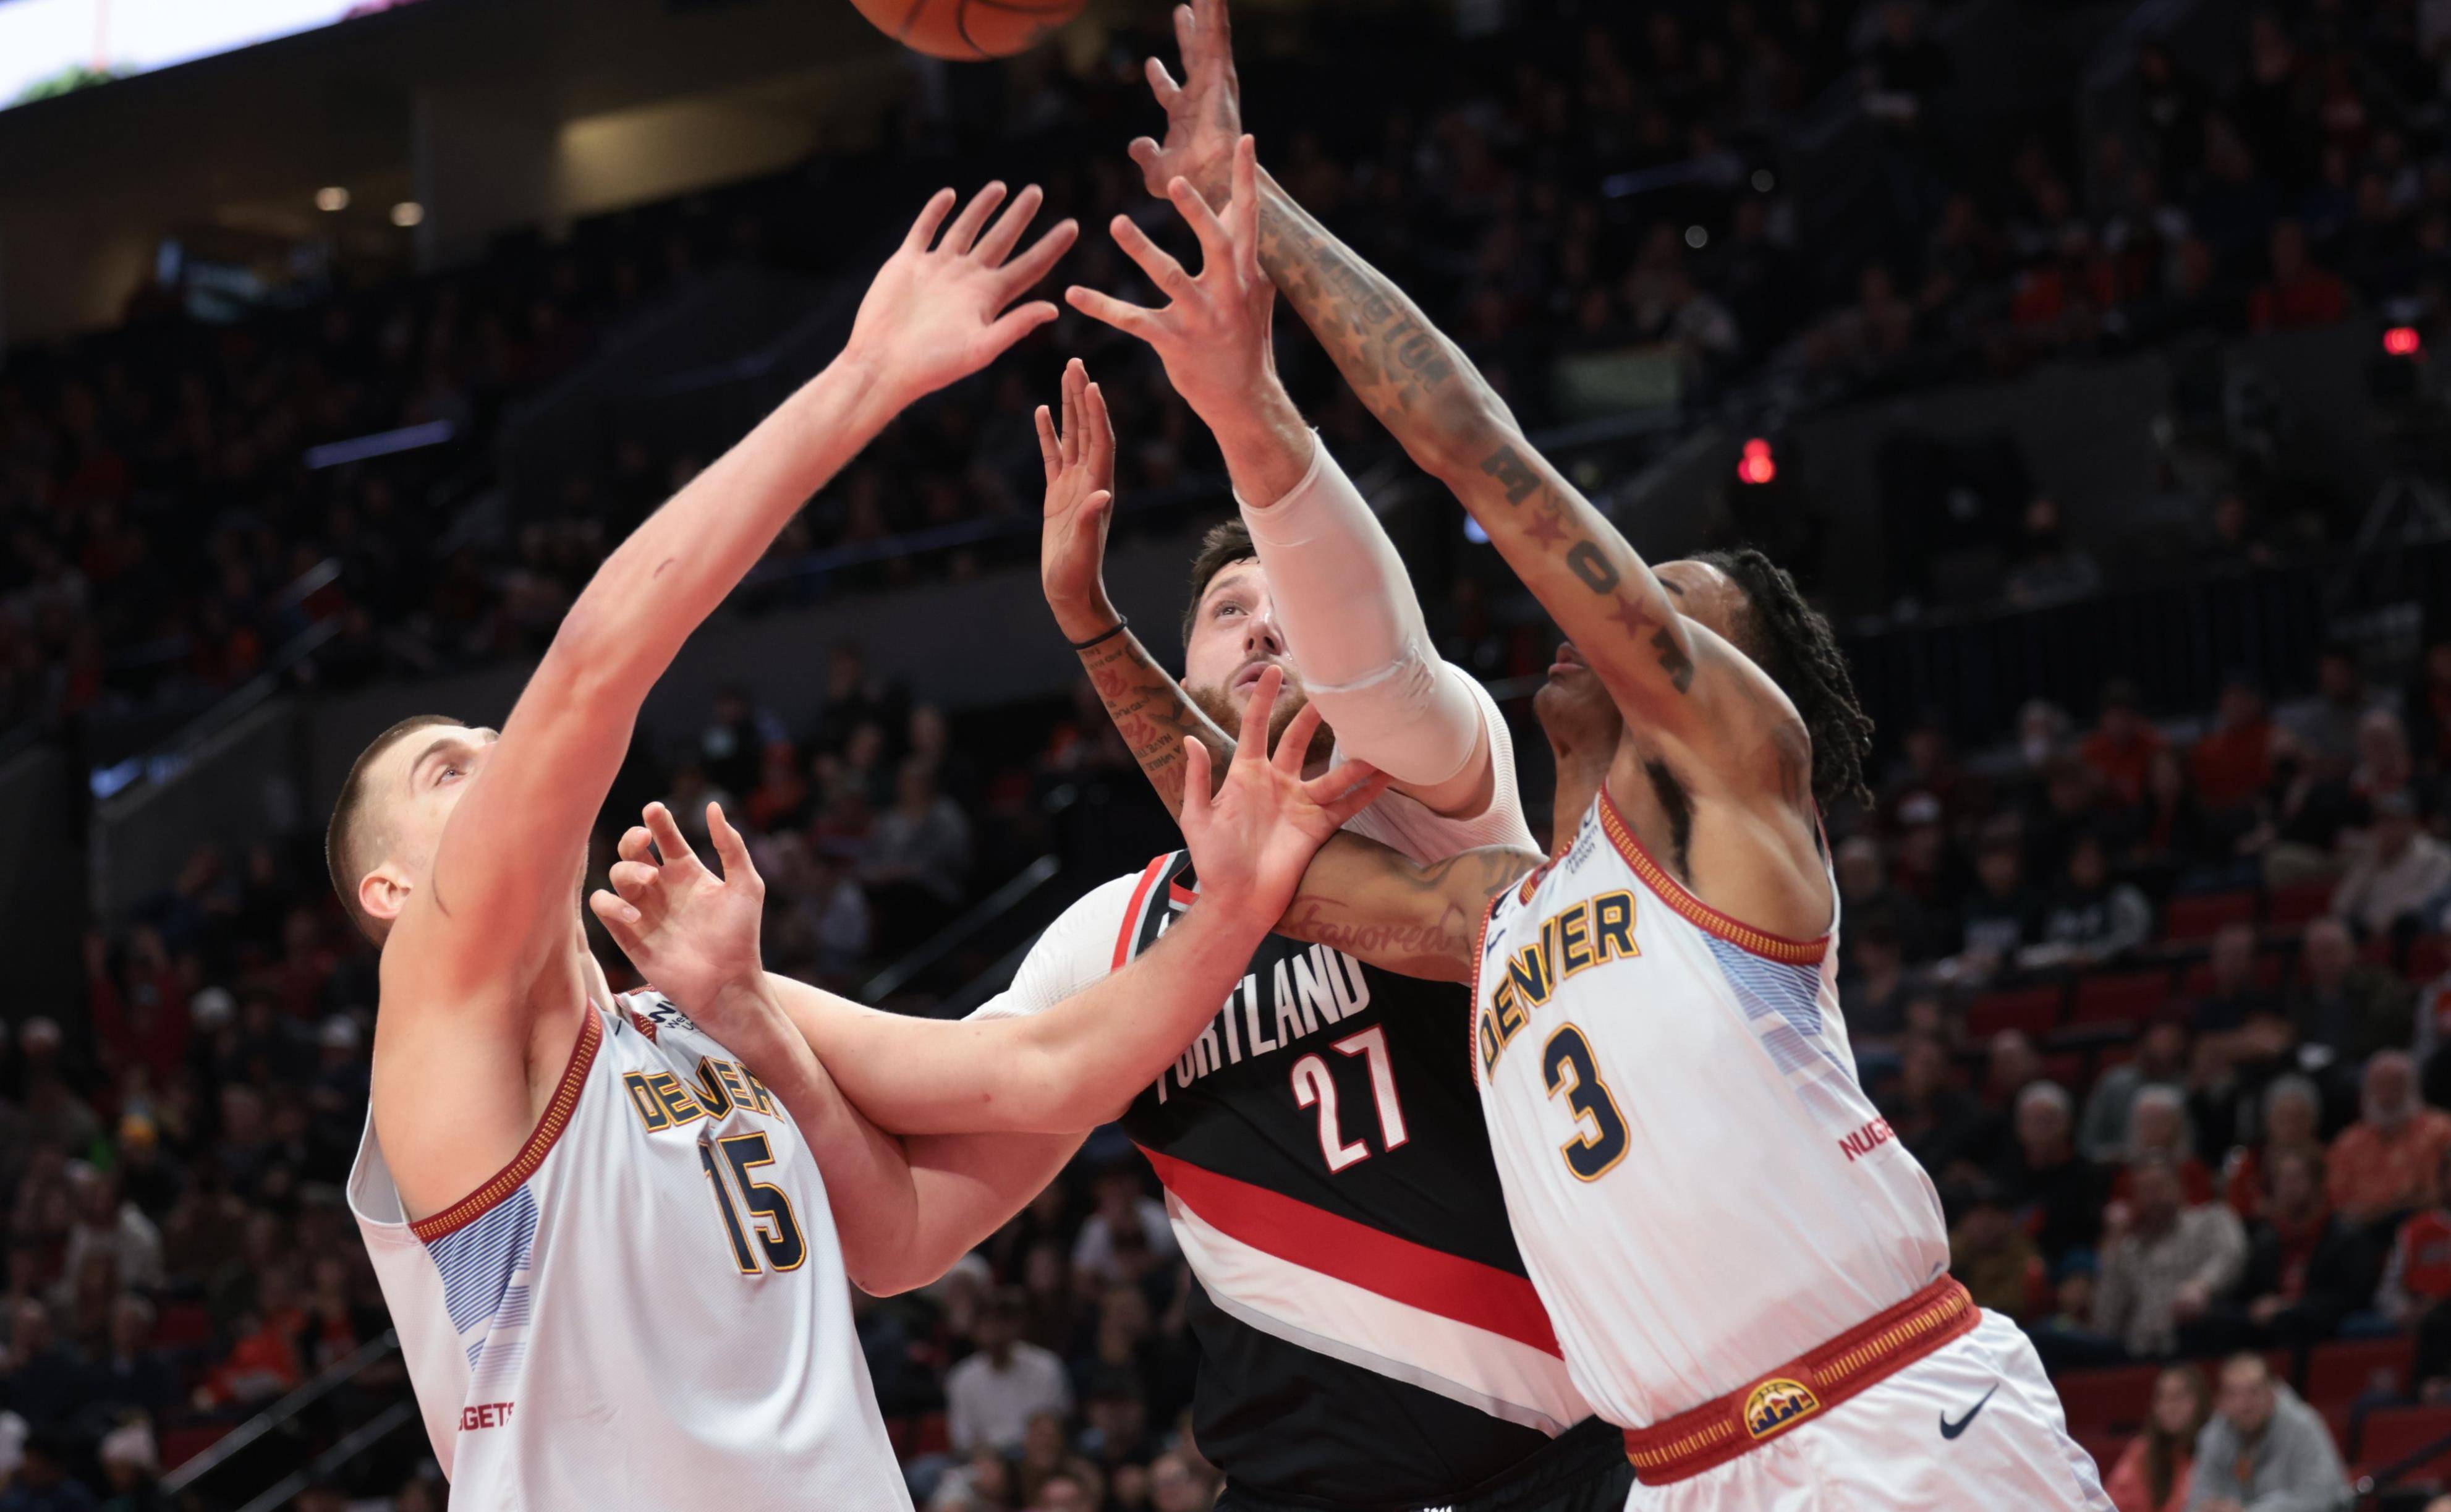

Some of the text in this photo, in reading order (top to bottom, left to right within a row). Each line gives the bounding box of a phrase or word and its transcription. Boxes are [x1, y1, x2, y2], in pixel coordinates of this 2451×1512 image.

[1157, 943, 1370, 1105] RTLAND
[1479, 889, 1641, 1086] DENVER
[1289, 1022, 1409, 1175] 27
[1540, 1021, 1631, 1183] 3
[697, 1131, 807, 1275] 15
